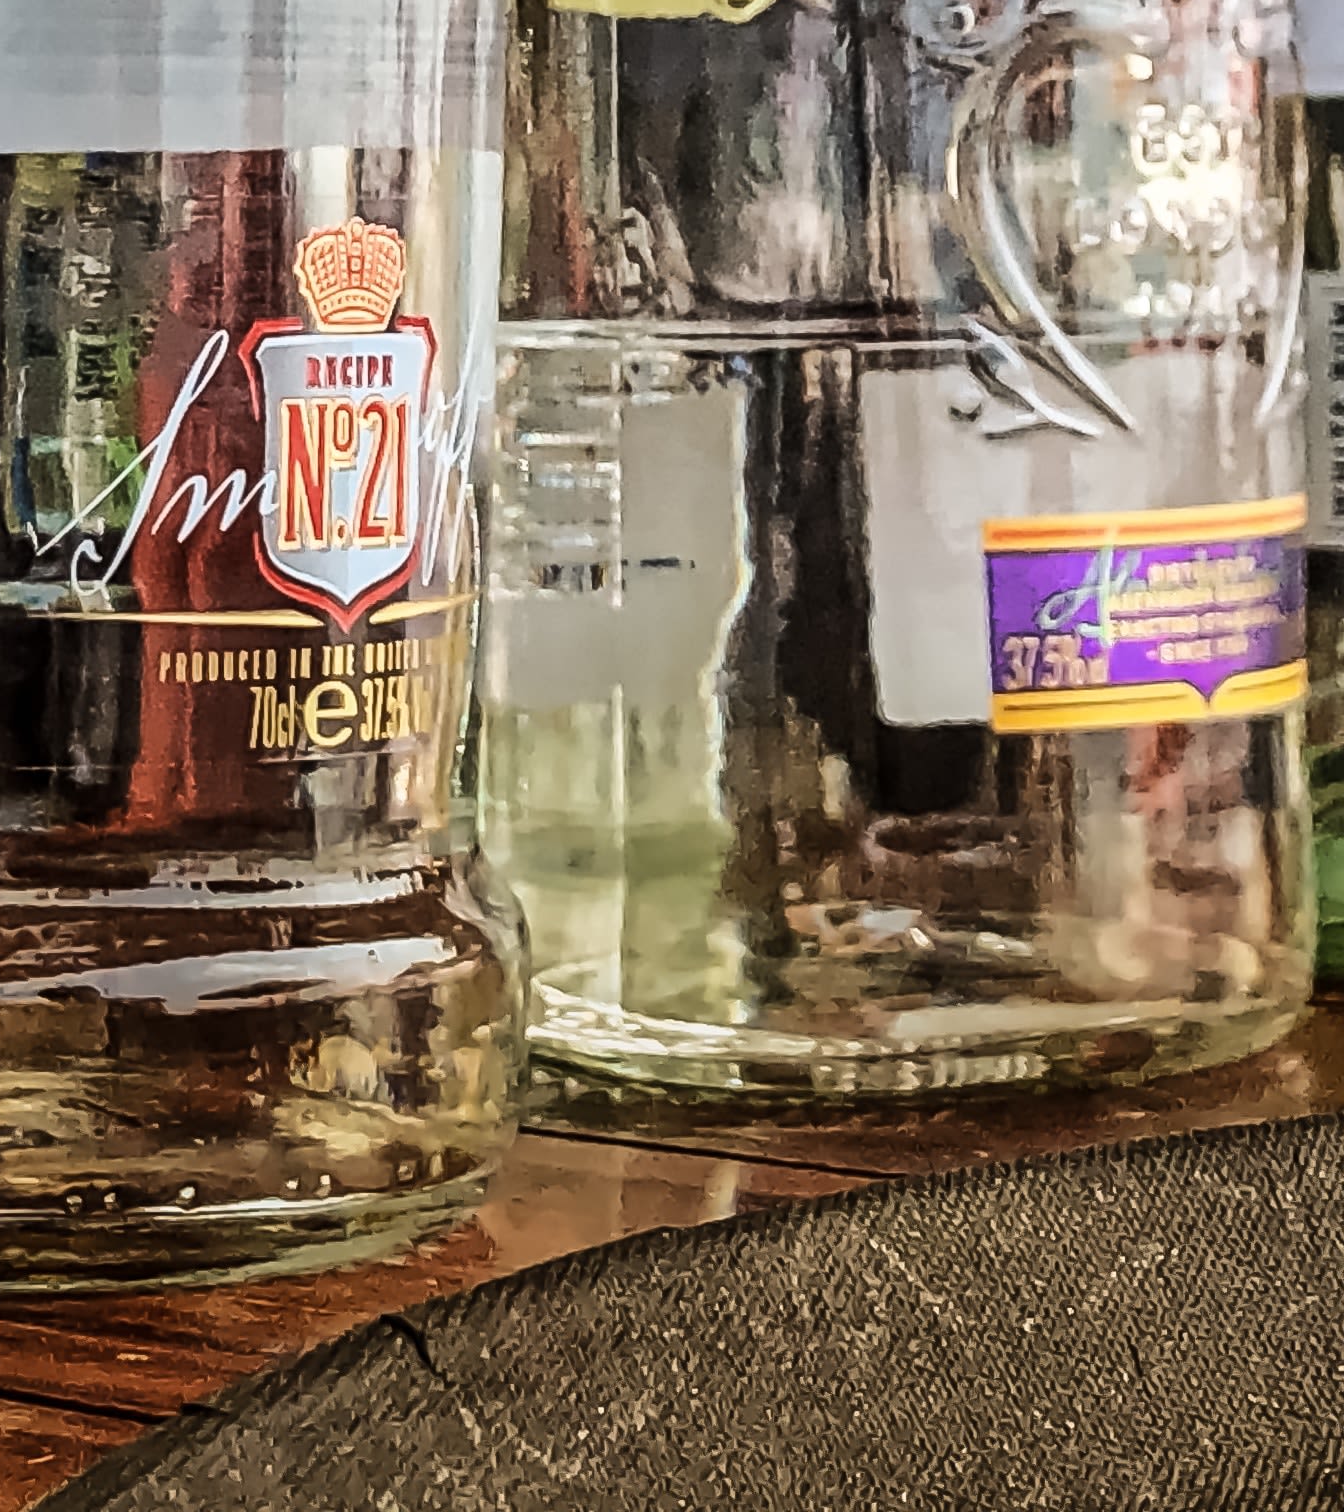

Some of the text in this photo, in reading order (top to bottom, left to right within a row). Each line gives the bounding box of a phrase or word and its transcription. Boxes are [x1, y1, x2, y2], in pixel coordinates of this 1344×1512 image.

[159, 649, 277, 683] PRODUCED
[290, 647, 312, 679] IN
[322, 643, 355, 677] THE
[250, 686, 296, 750] 70cl
